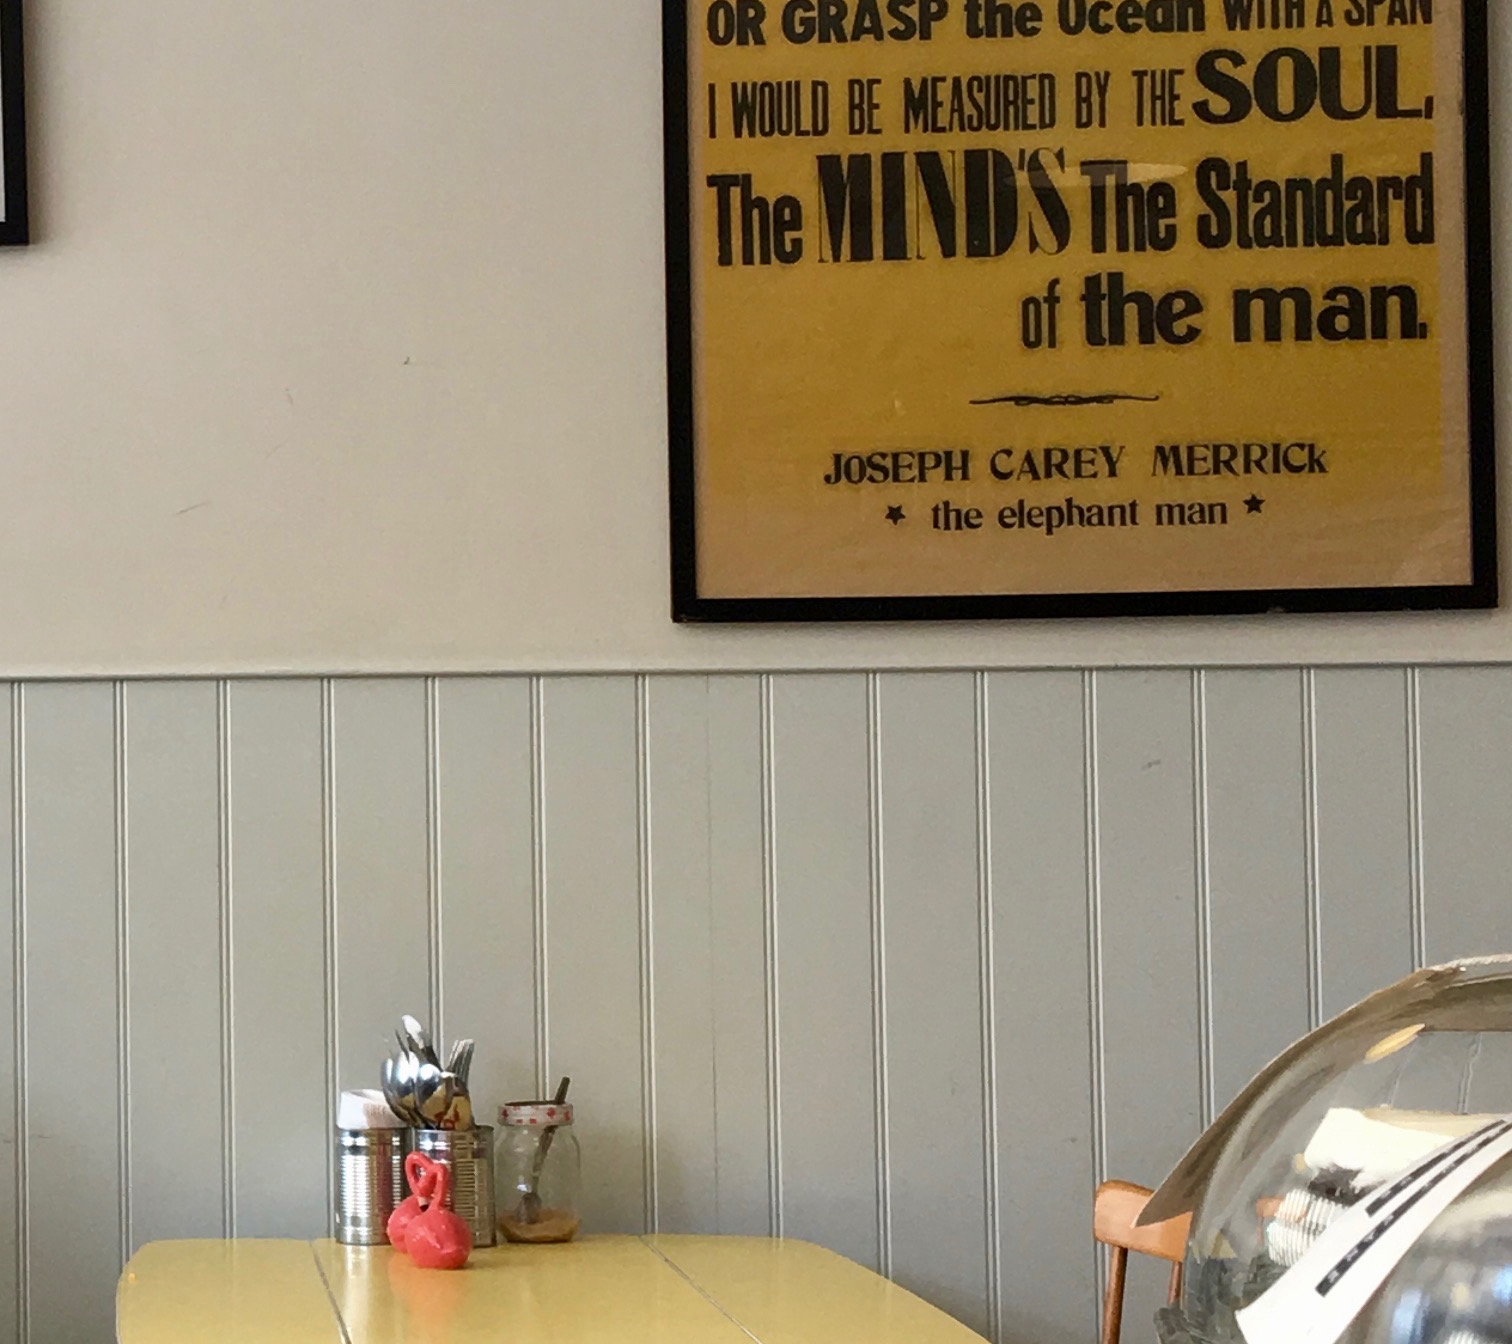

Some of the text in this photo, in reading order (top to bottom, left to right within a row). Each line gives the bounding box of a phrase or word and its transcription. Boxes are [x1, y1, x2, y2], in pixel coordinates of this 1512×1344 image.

[707, 44, 1434, 140] I WOULD BE MEASURED BY THE SOUL,
[705, 146, 1436, 268] The MIND'S The Standard
[1021, 271, 1429, 350] of the man.
[823, 449, 971, 486] JOSEPH
[989, 445, 1126, 482] CAREY
[931, 496, 1228, 537] the elephant man
